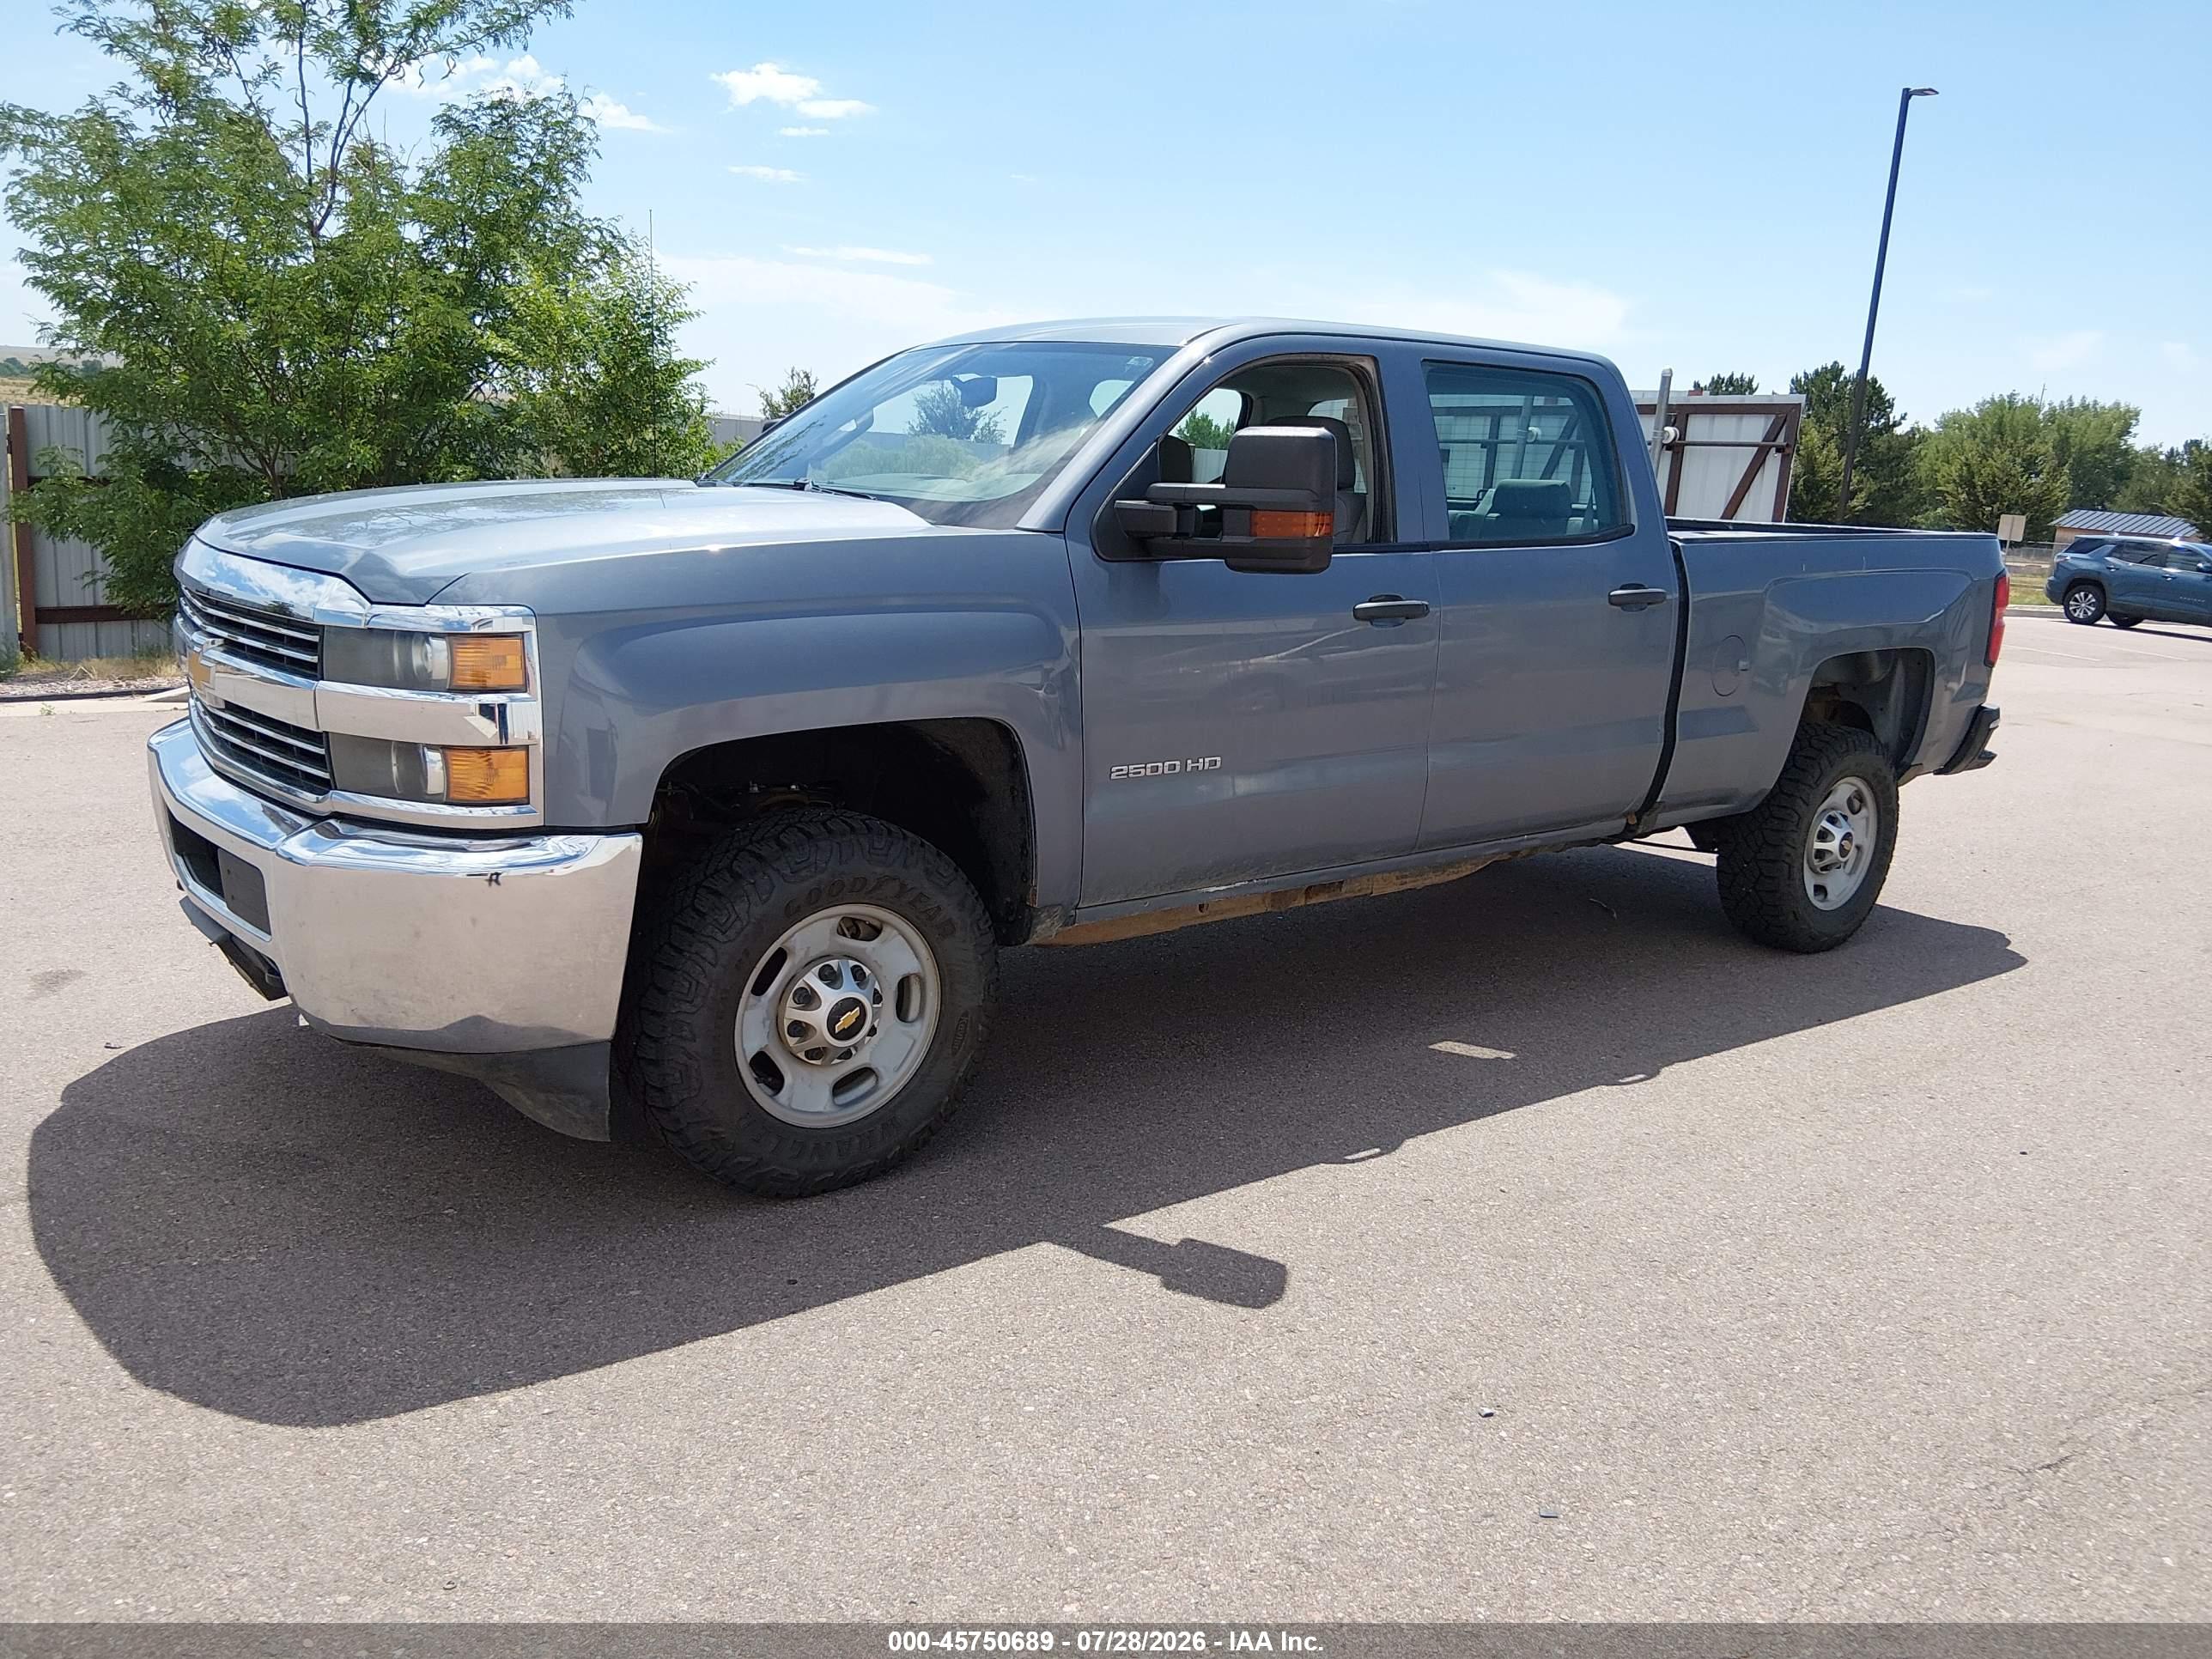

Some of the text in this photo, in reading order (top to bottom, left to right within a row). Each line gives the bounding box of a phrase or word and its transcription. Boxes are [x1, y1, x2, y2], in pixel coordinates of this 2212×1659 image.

[1110, 756, 1221, 780] 2500 HD
[785, 875, 957, 939] GOODYEAR
